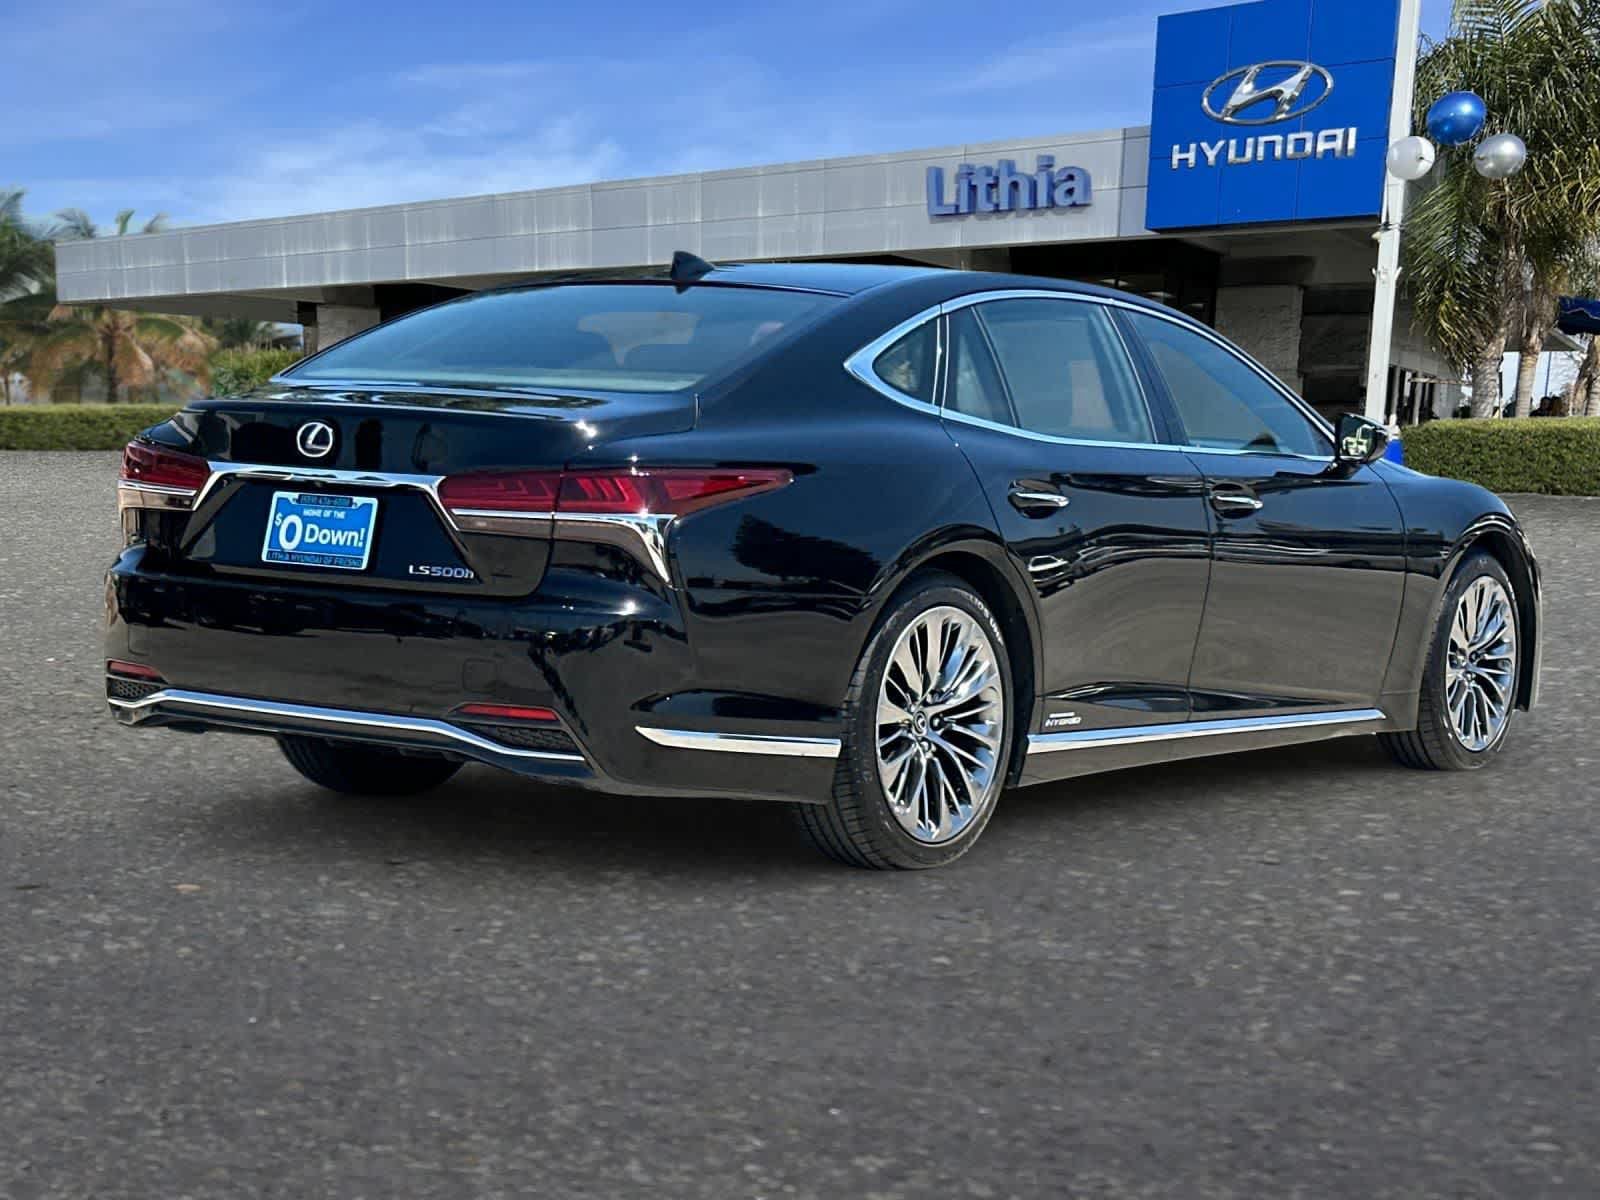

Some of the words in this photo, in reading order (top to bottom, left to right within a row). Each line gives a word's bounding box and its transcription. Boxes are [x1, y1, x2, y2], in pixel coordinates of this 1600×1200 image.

[1170, 127, 1357, 169] HYUNDAI
[926, 155, 1092, 216] Lithia
[303, 508, 322, 517] HOME
[323, 510, 331, 518] OF
[334, 511, 346, 519] THE
[304, 522, 363, 548] Down!
[408, 564, 474, 579] LS500h
